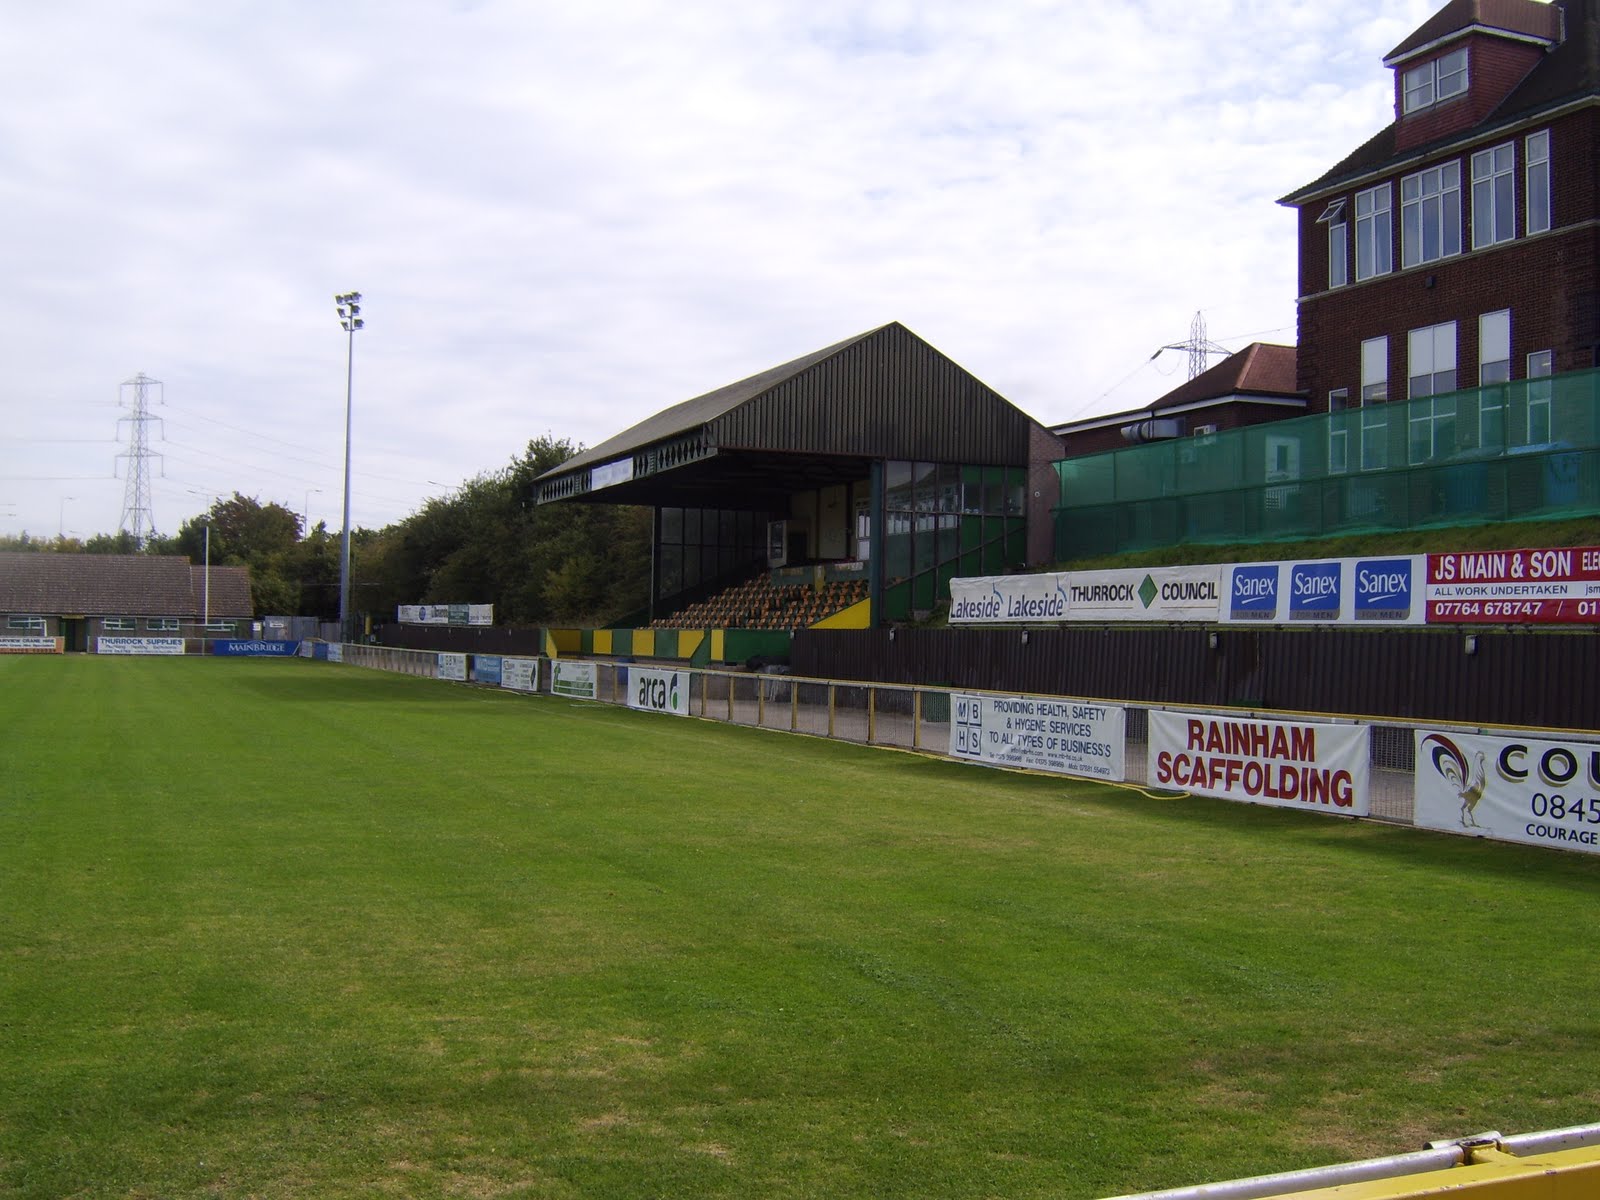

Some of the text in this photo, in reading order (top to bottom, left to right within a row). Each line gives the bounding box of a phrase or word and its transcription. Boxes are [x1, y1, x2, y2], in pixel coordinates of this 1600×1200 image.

[1435, 551, 1600, 580] JS MAIN & SON ELE
[1071, 582, 1218, 602] THURROCK COUNCIL
[1235, 575, 1275, 596] Sanex
[1294, 573, 1337, 594] Sanex
[1359, 570, 1408, 593] Sanex
[1434, 587, 1453, 596] ALL
[1455, 586, 1488, 596] WORK
[1491, 585, 1568, 595] UNDERTAKEN
[950, 593, 1000, 619] Lakeside
[1007, 592, 1063, 618] Lakeside
[1435, 602, 1480, 616] 07764
[1484, 602, 1542, 615] 678747
[1577, 601, 1600, 615] 01
[639, 676, 666, 709] arca
[972, 704, 979, 719] B
[993, 700, 1106, 722] PROVIDING HEALTH, SAFETY
[1006, 717, 1092, 738] & HYGENE SERVICES
[959, 731, 978, 748] H S
[989, 730, 1111, 758] TO ALL TYPES OF BUSINESS'S
[1187, 719, 1315, 763] RAINHAM
[1157, 751, 1353, 807] SCAFFOLDING
[1526, 823, 1598, 845] COURAGE
